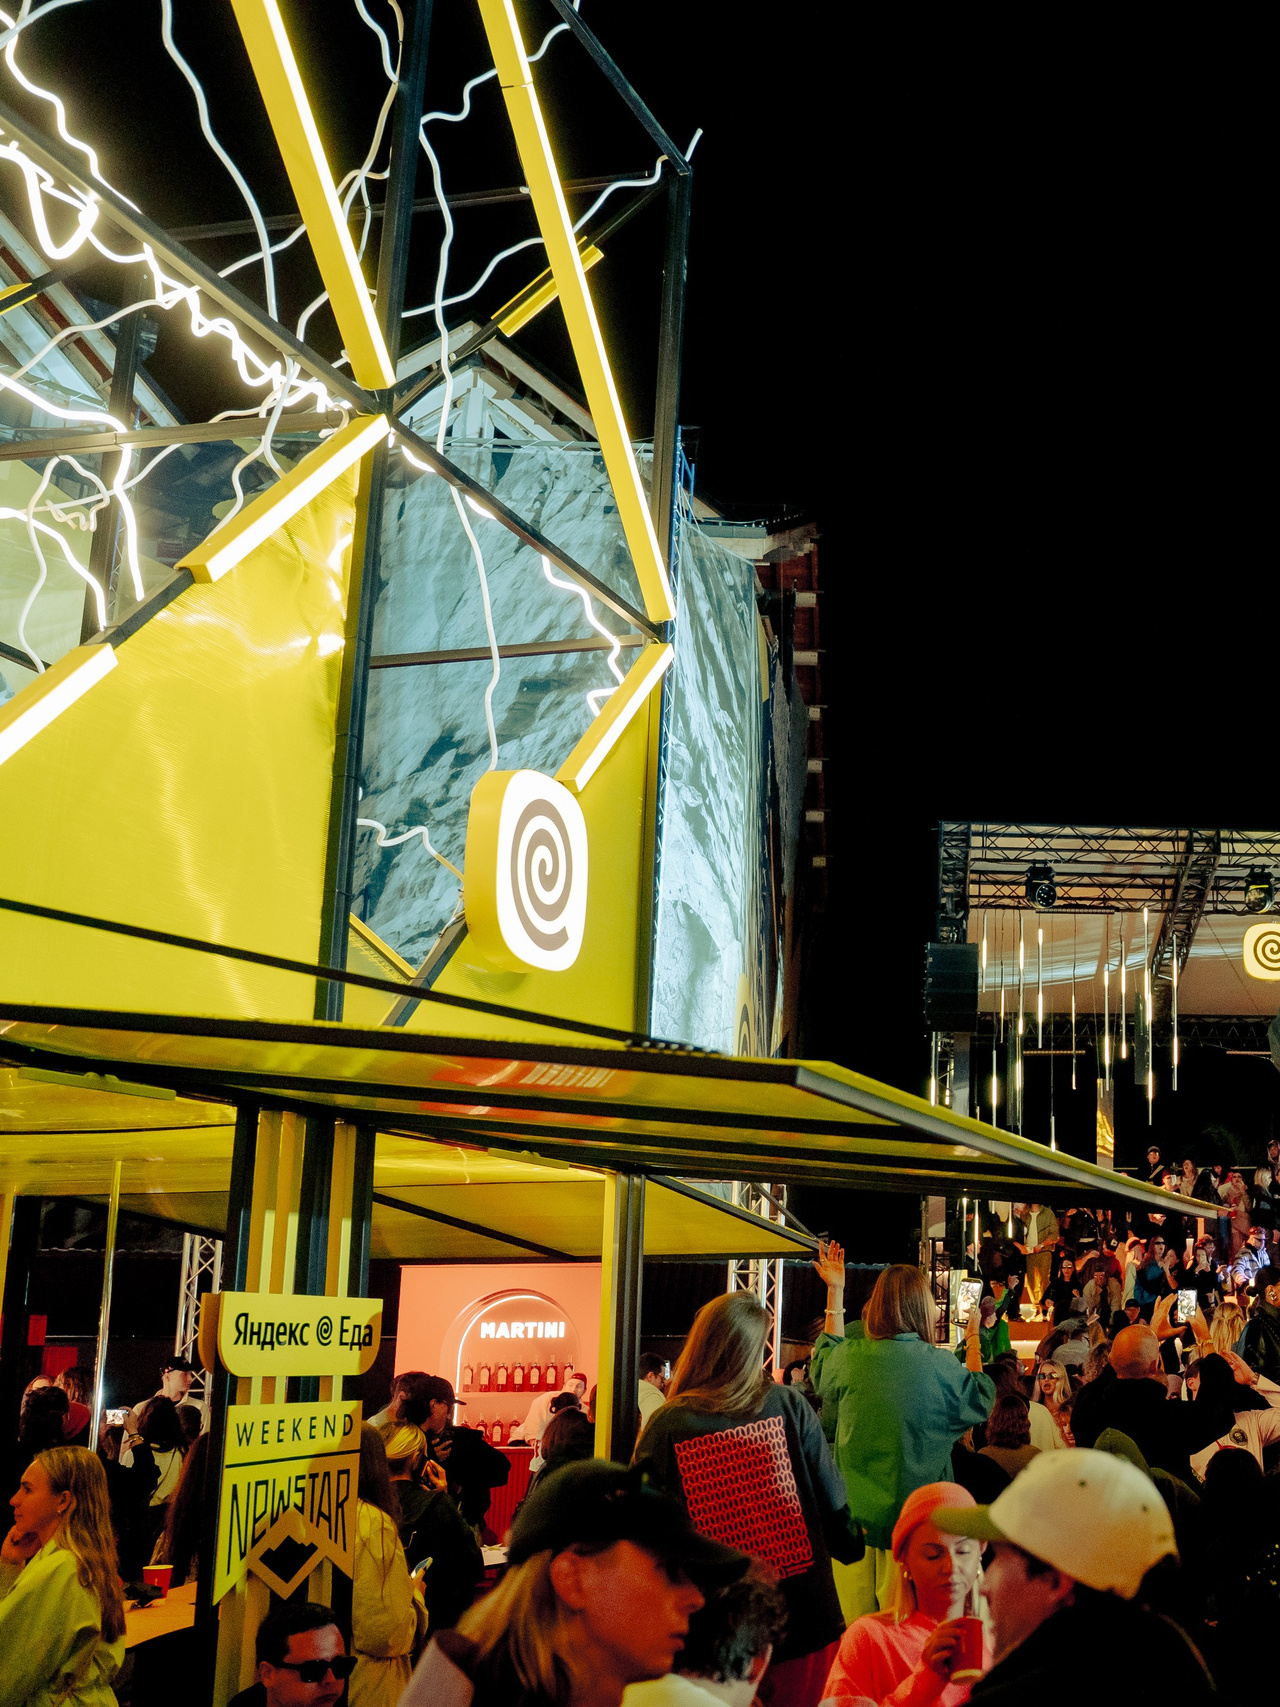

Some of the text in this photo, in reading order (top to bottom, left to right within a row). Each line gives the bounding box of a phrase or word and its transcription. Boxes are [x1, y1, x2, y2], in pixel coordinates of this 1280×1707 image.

[232, 1312, 374, 1352] Яндекс Еда
[479, 1321, 566, 1339] MARTINI
[235, 1413, 354, 1448] WEEKEND
